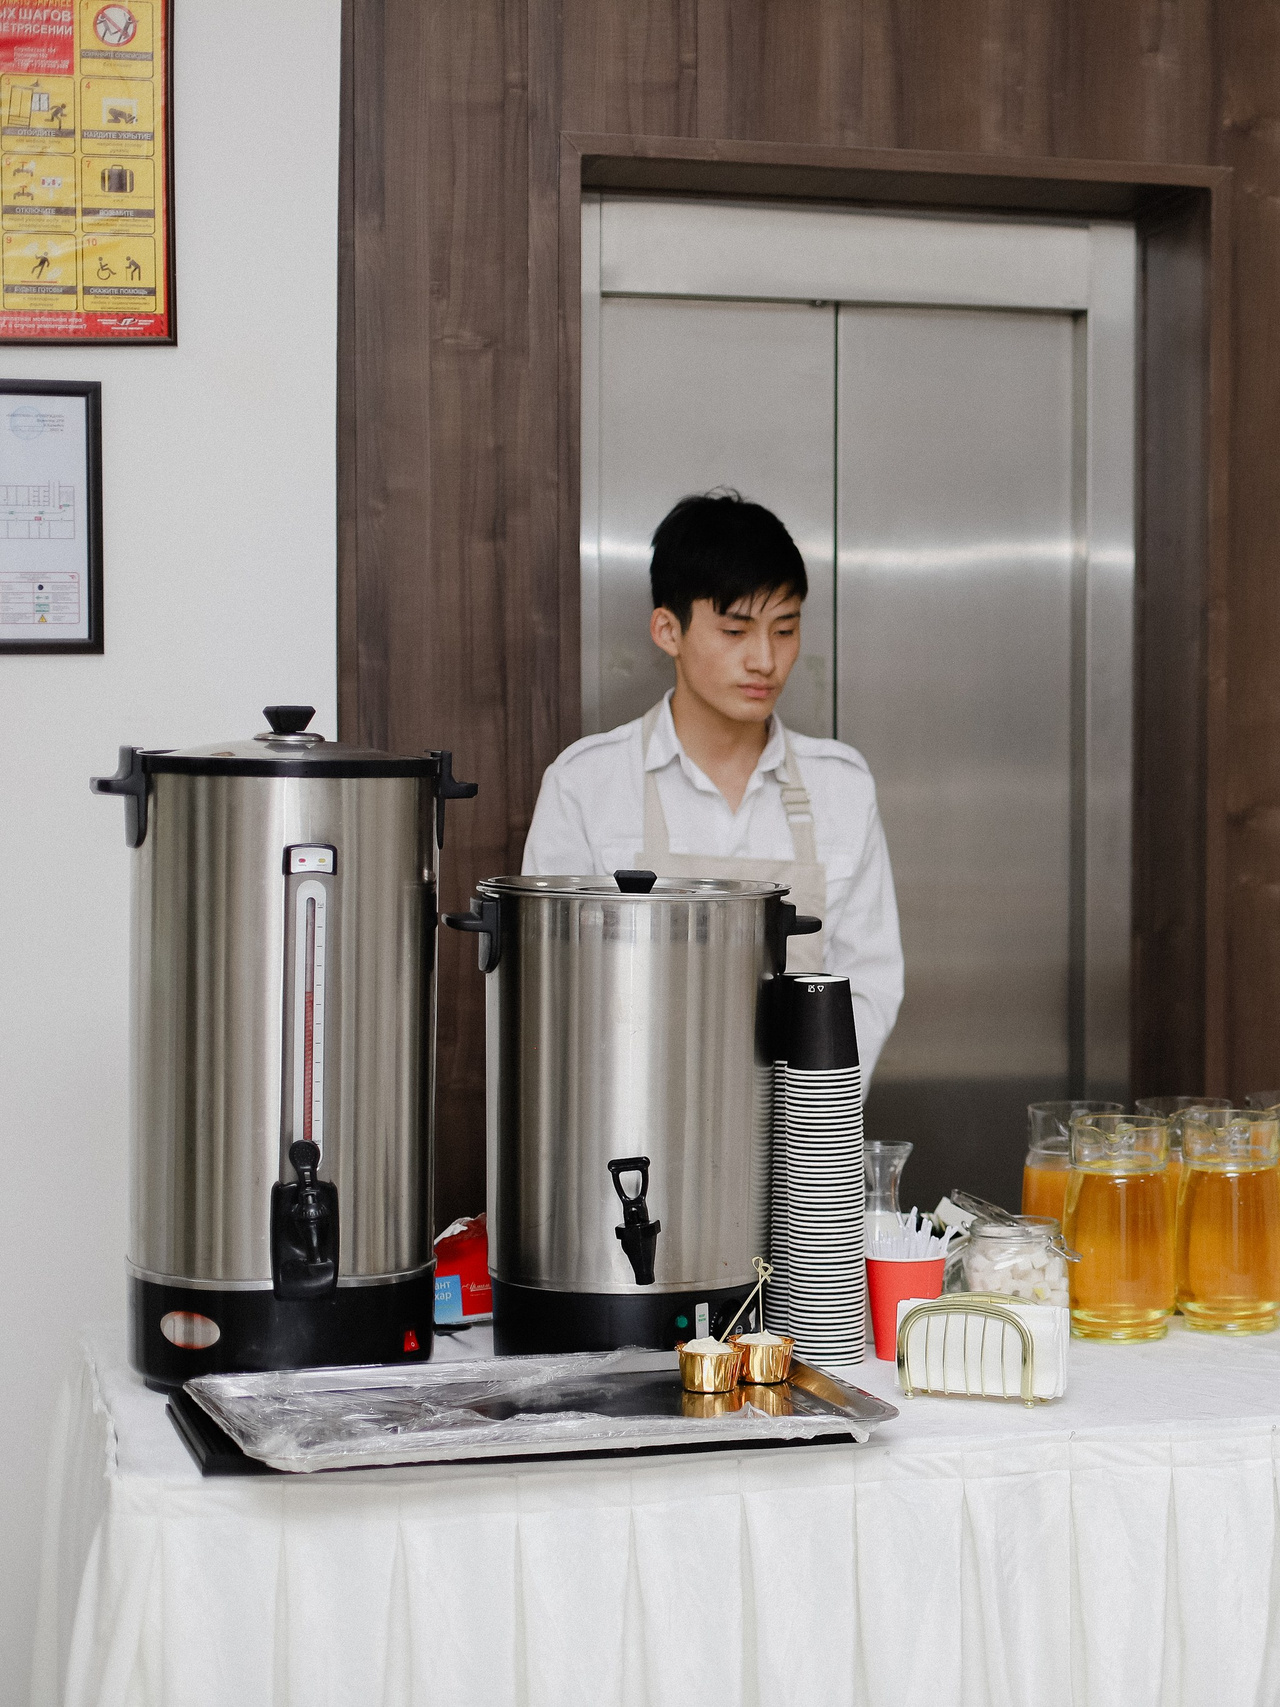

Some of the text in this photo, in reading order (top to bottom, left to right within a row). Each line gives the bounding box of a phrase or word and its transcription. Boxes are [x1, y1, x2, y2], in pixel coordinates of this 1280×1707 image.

[19, 8, 71, 22] ШАГОВ
[0, 22, 73, 35] ЕТРЯСЕНИИ
[17, 129, 56, 137] ОТОЙДИТЕ
[87, 238, 97, 246] 10
